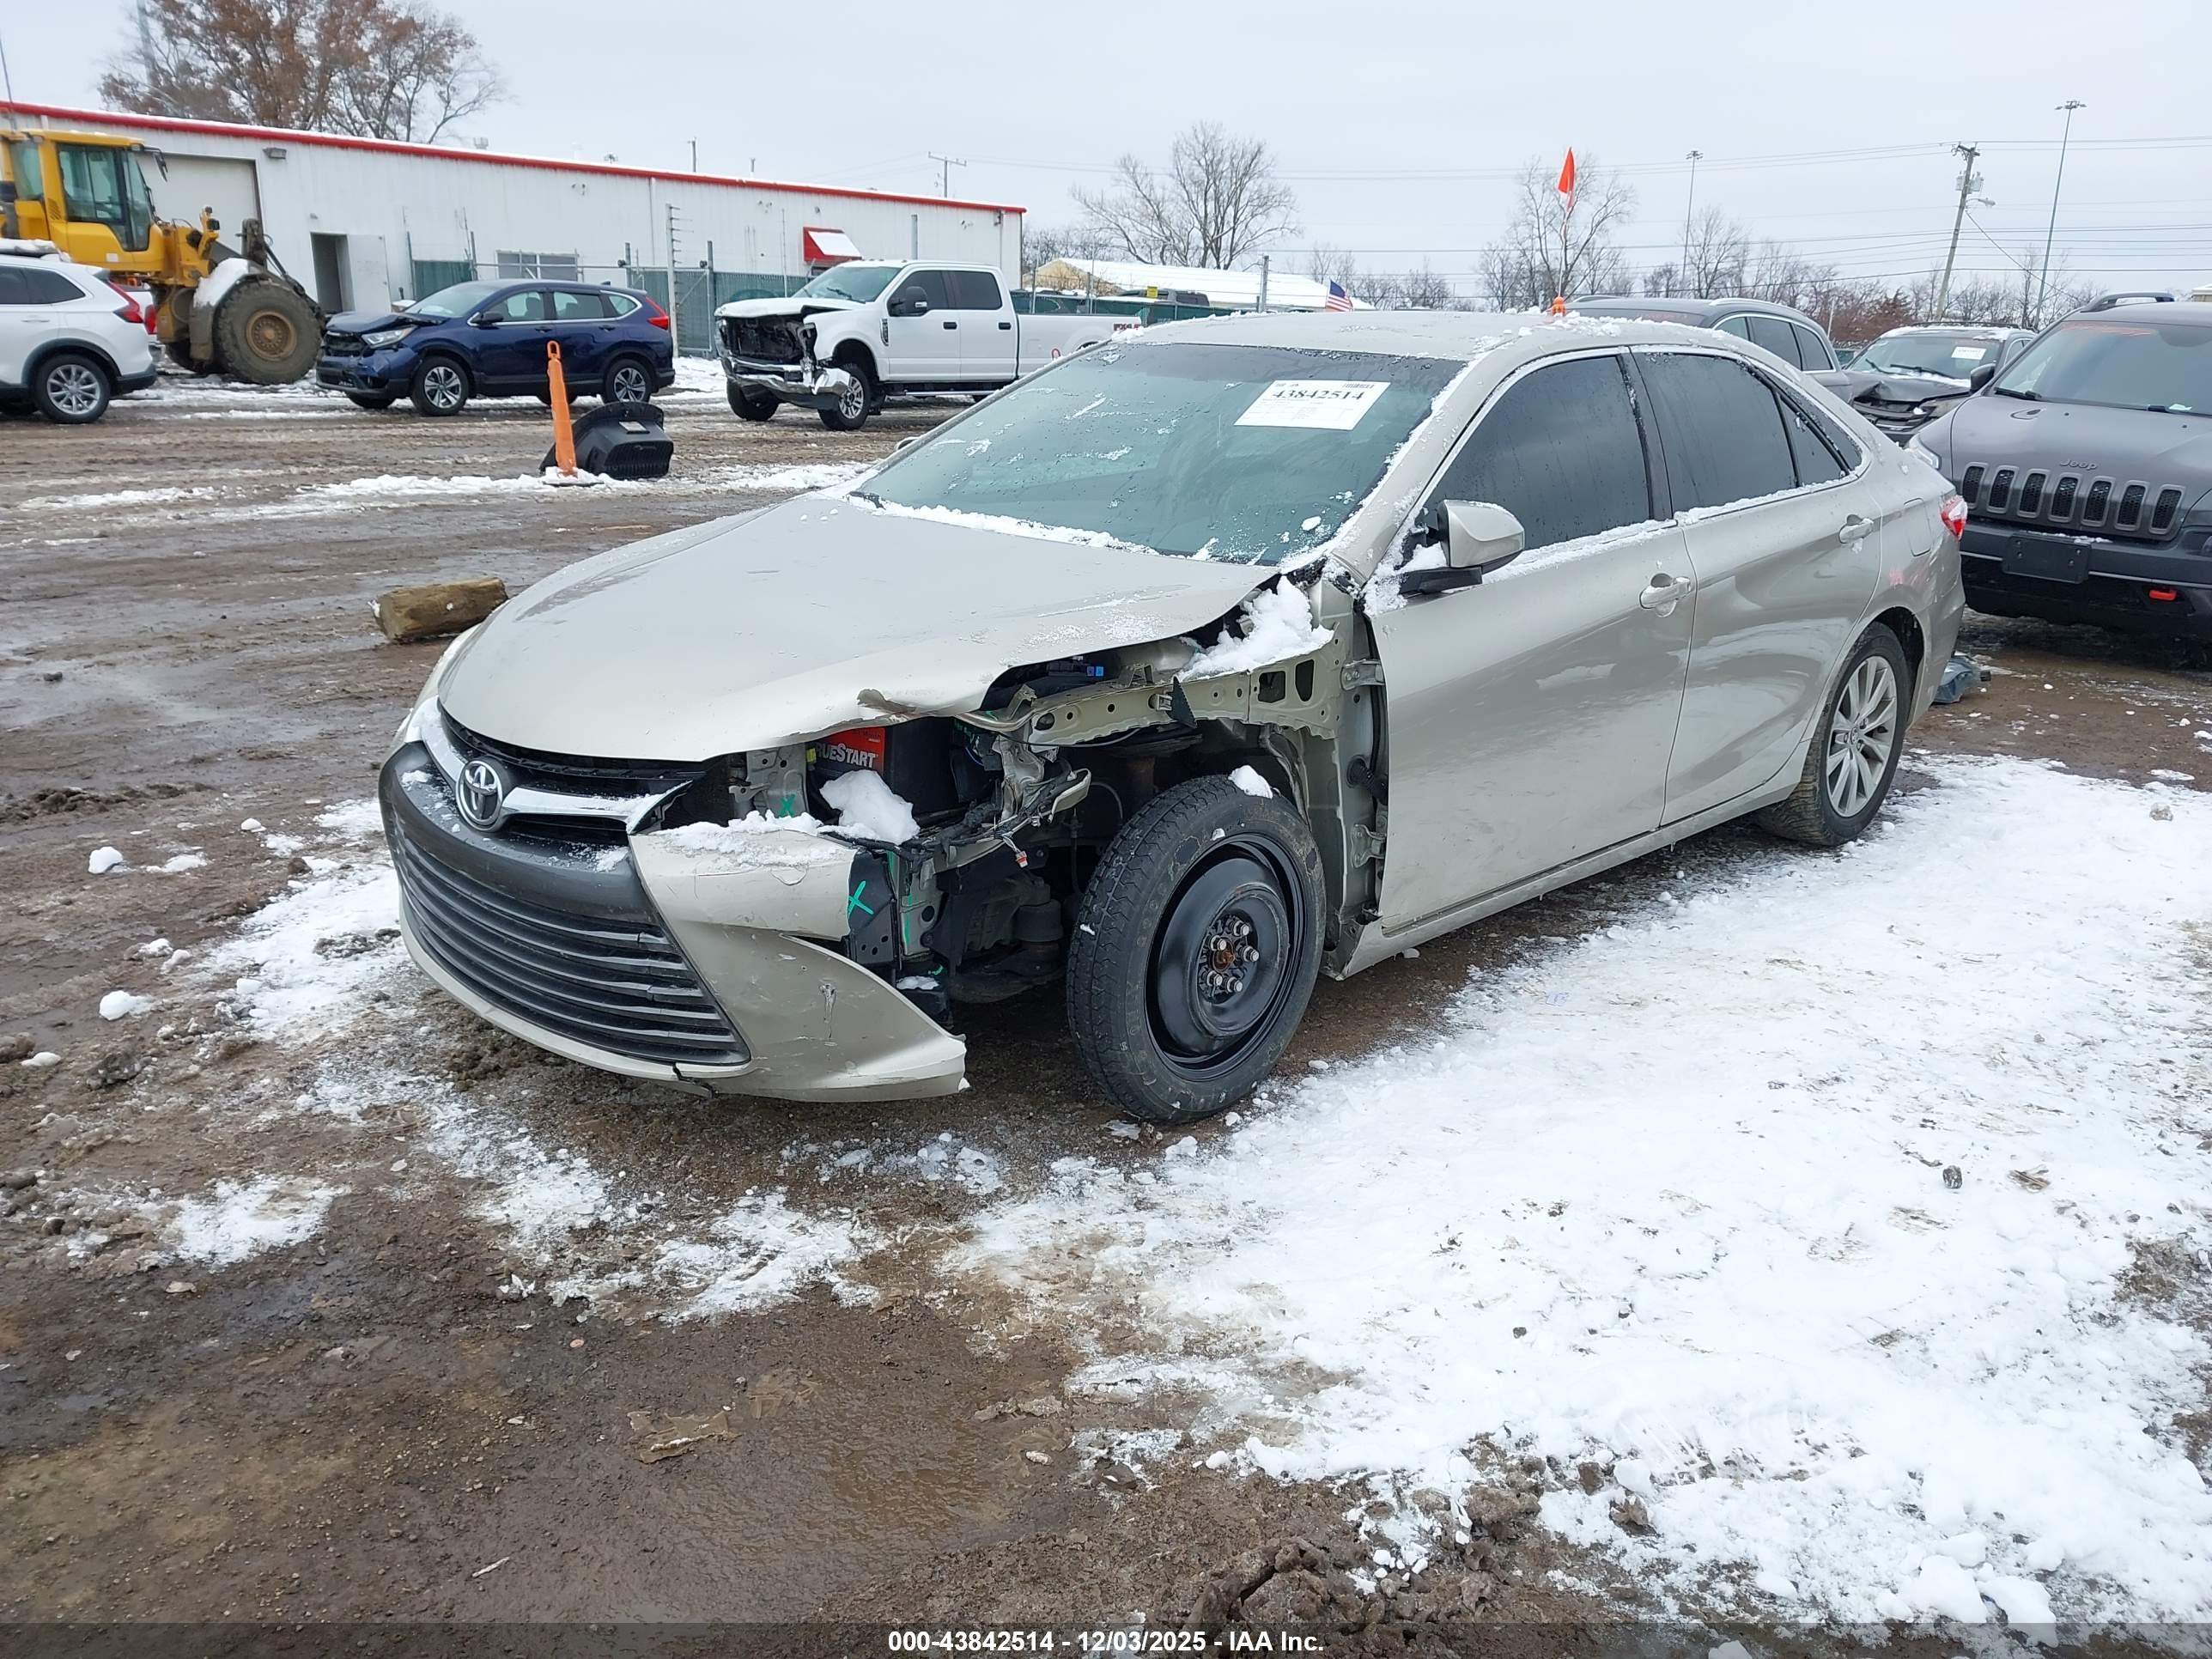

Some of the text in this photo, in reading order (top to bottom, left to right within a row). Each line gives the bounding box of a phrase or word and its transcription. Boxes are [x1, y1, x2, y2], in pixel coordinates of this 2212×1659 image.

[1272, 390, 1365, 400] 43842514
[2060, 459, 2097, 471] Jeep
[815, 742, 876, 768] RUESTART
